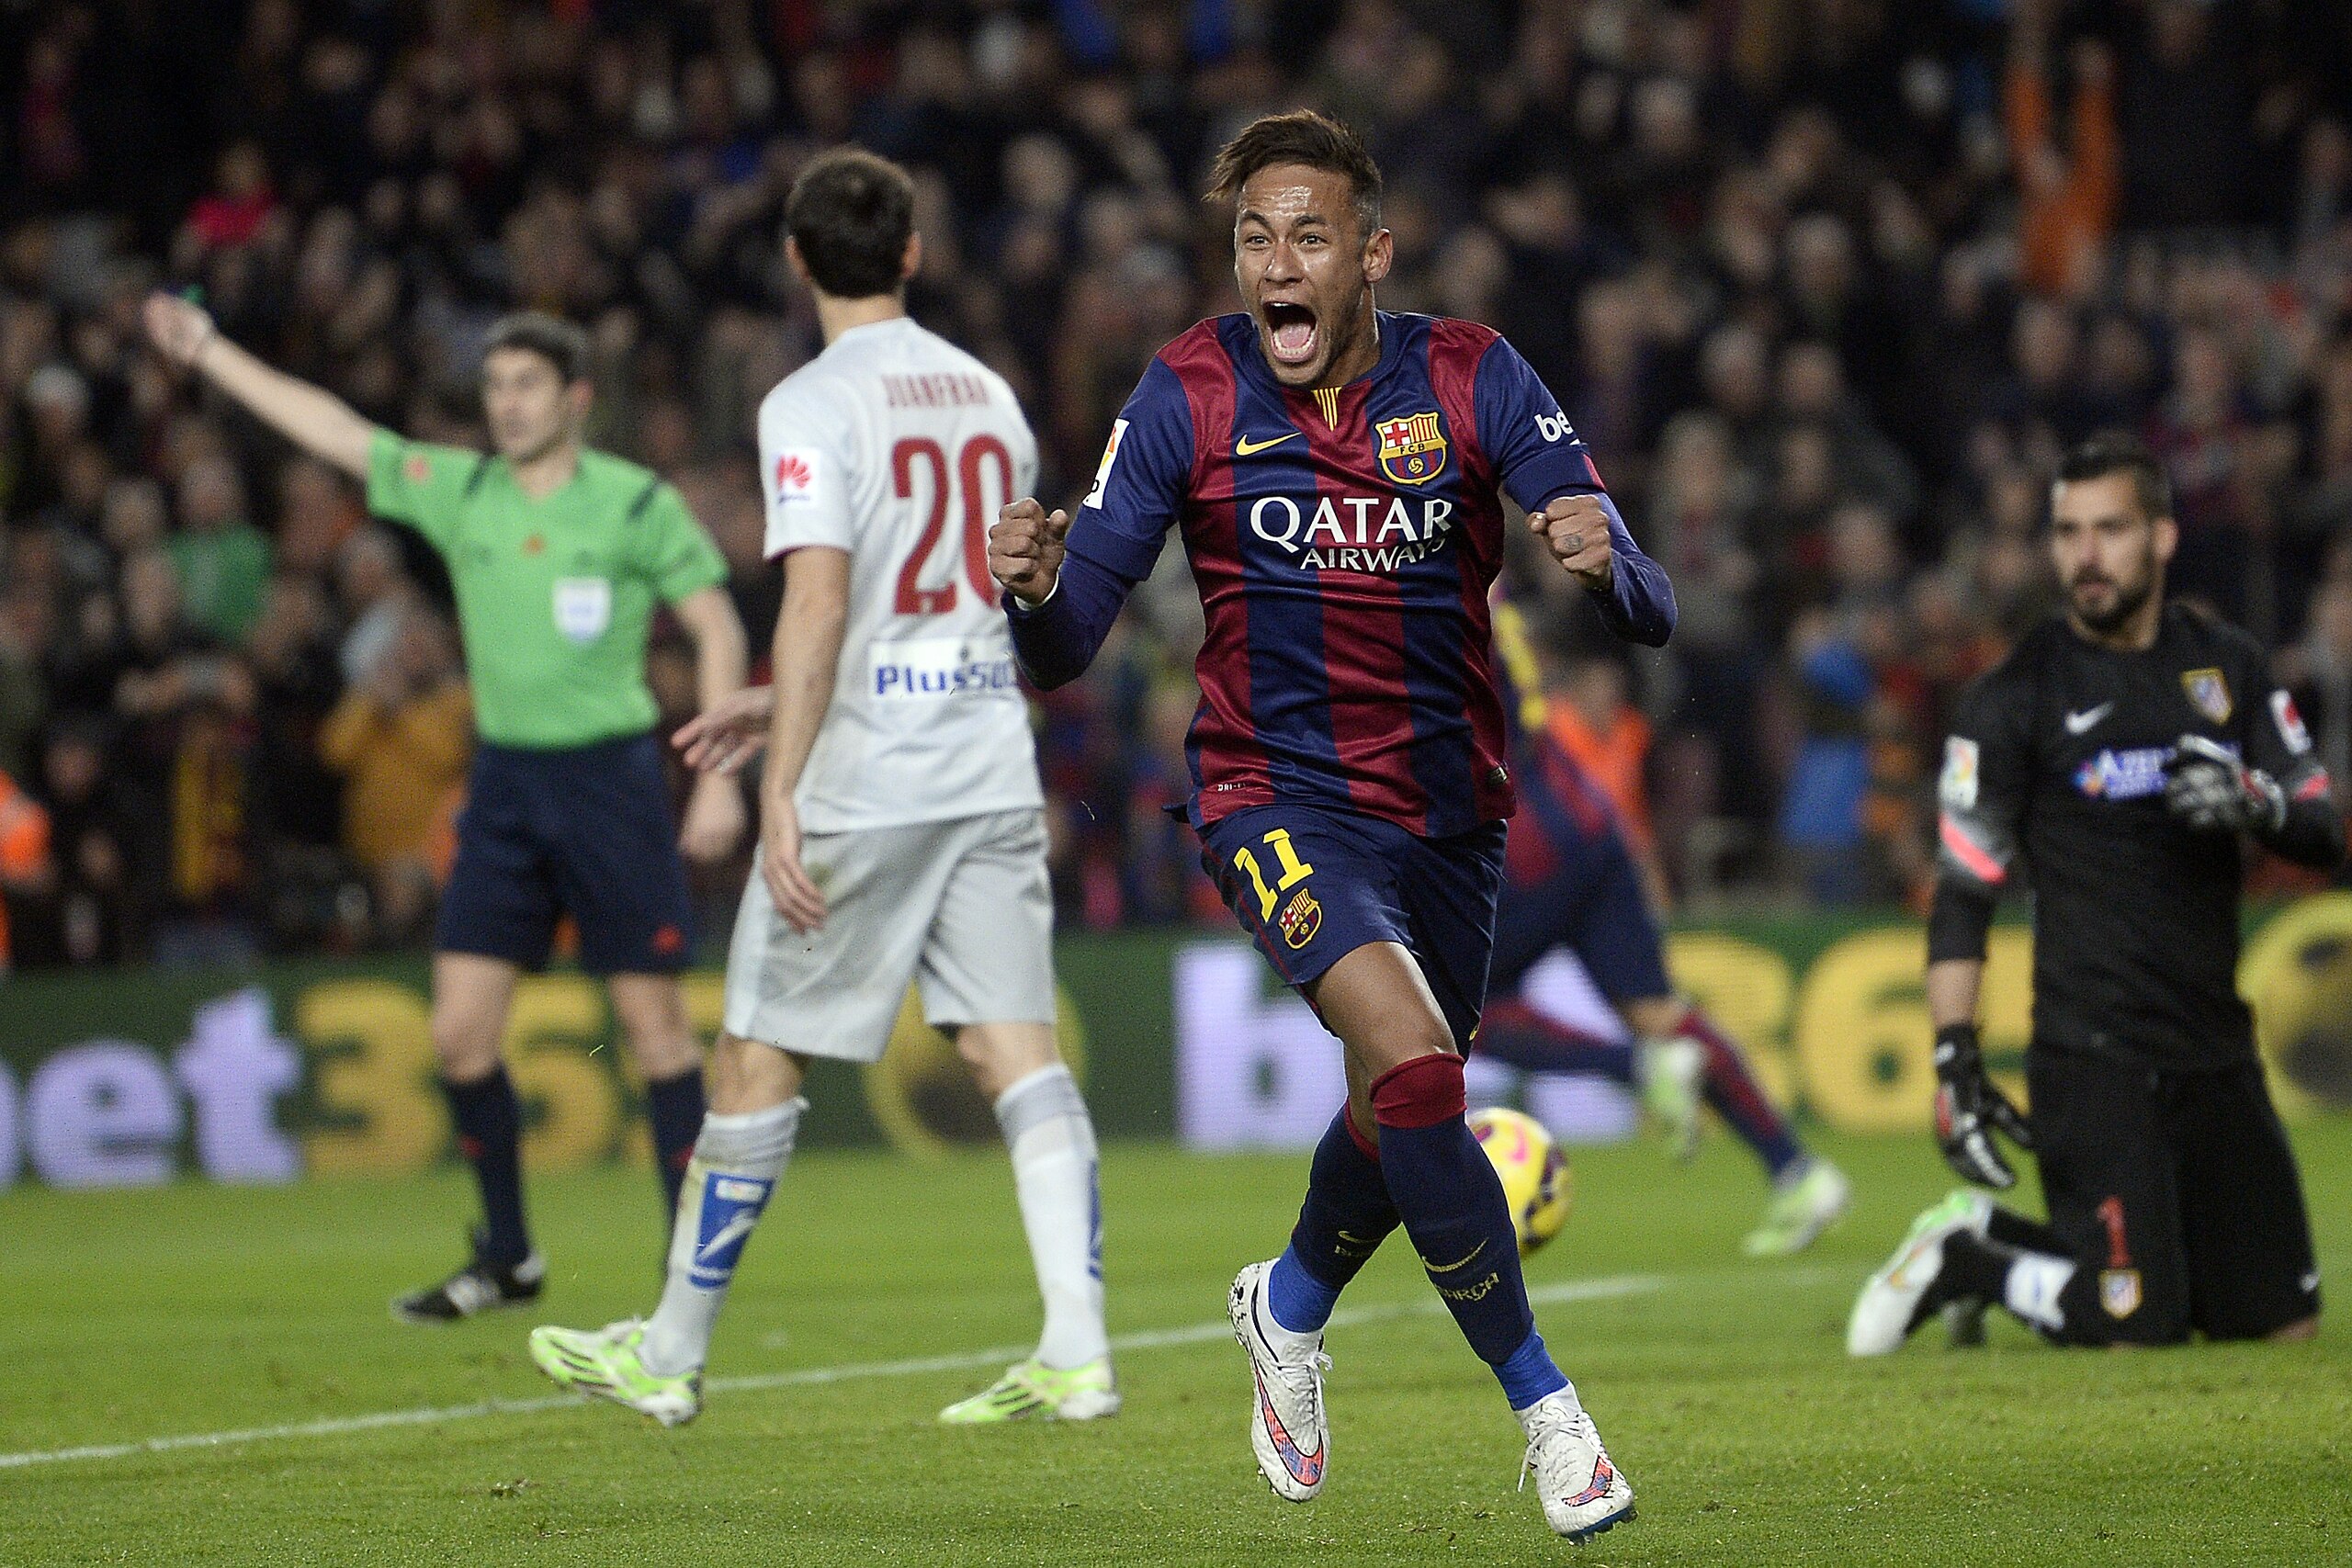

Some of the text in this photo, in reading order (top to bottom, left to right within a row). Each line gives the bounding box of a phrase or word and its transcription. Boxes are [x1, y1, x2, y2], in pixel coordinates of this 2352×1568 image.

[1533, 411, 1580, 446] be
[892, 434, 1013, 615] 20
[1250, 495, 1453, 554] QATAR
[1299, 536, 1446, 573] AIRWAYS
[1233, 828, 1315, 923] 11
[2097, 1196, 2132, 1269] 1
